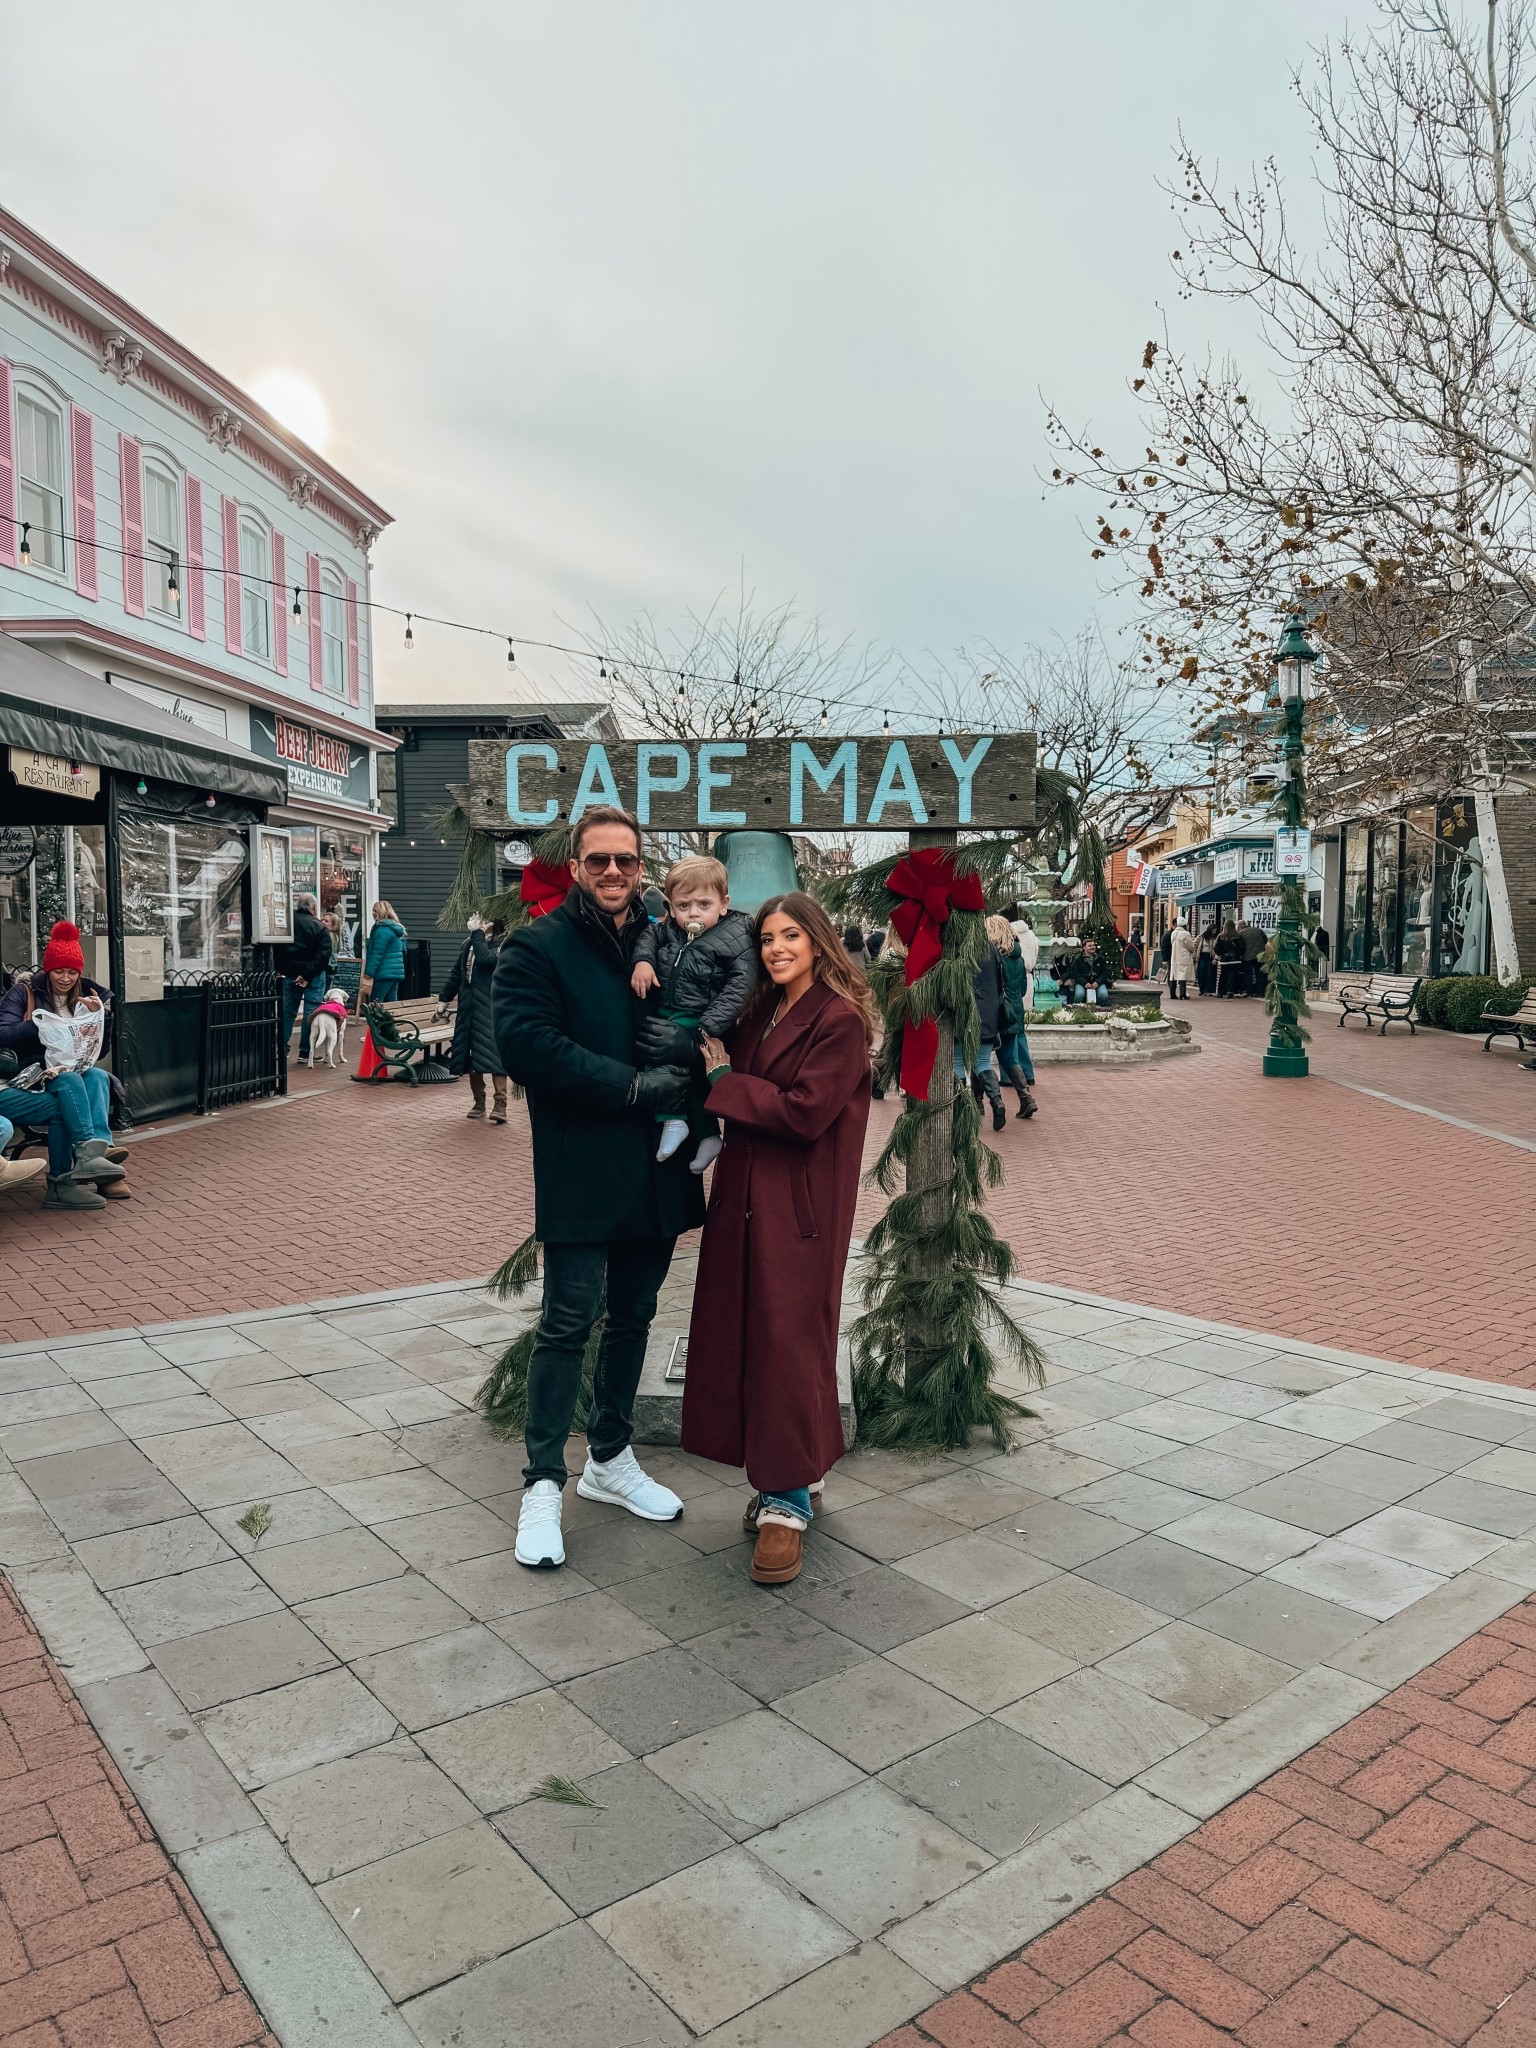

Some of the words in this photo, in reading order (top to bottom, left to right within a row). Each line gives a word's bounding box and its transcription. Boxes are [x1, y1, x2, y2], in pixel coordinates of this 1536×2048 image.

[274, 714, 309, 766] BEEF
[308, 728, 350, 778] JERKY
[24, 766, 91, 795] RESTAURANT
[287, 764, 343, 797] EXPERIENCE
[505, 742, 747, 826] CAPE
[790, 737, 994, 824] MAY
[1160, 880, 1193, 889] KITCHEN
[1161, 875, 1185, 883] FUDGE
[1248, 897, 1265, 910] CAPE
[1252, 912, 1277, 921] FUDGE
[1246, 920, 1278, 929] KITCHE
